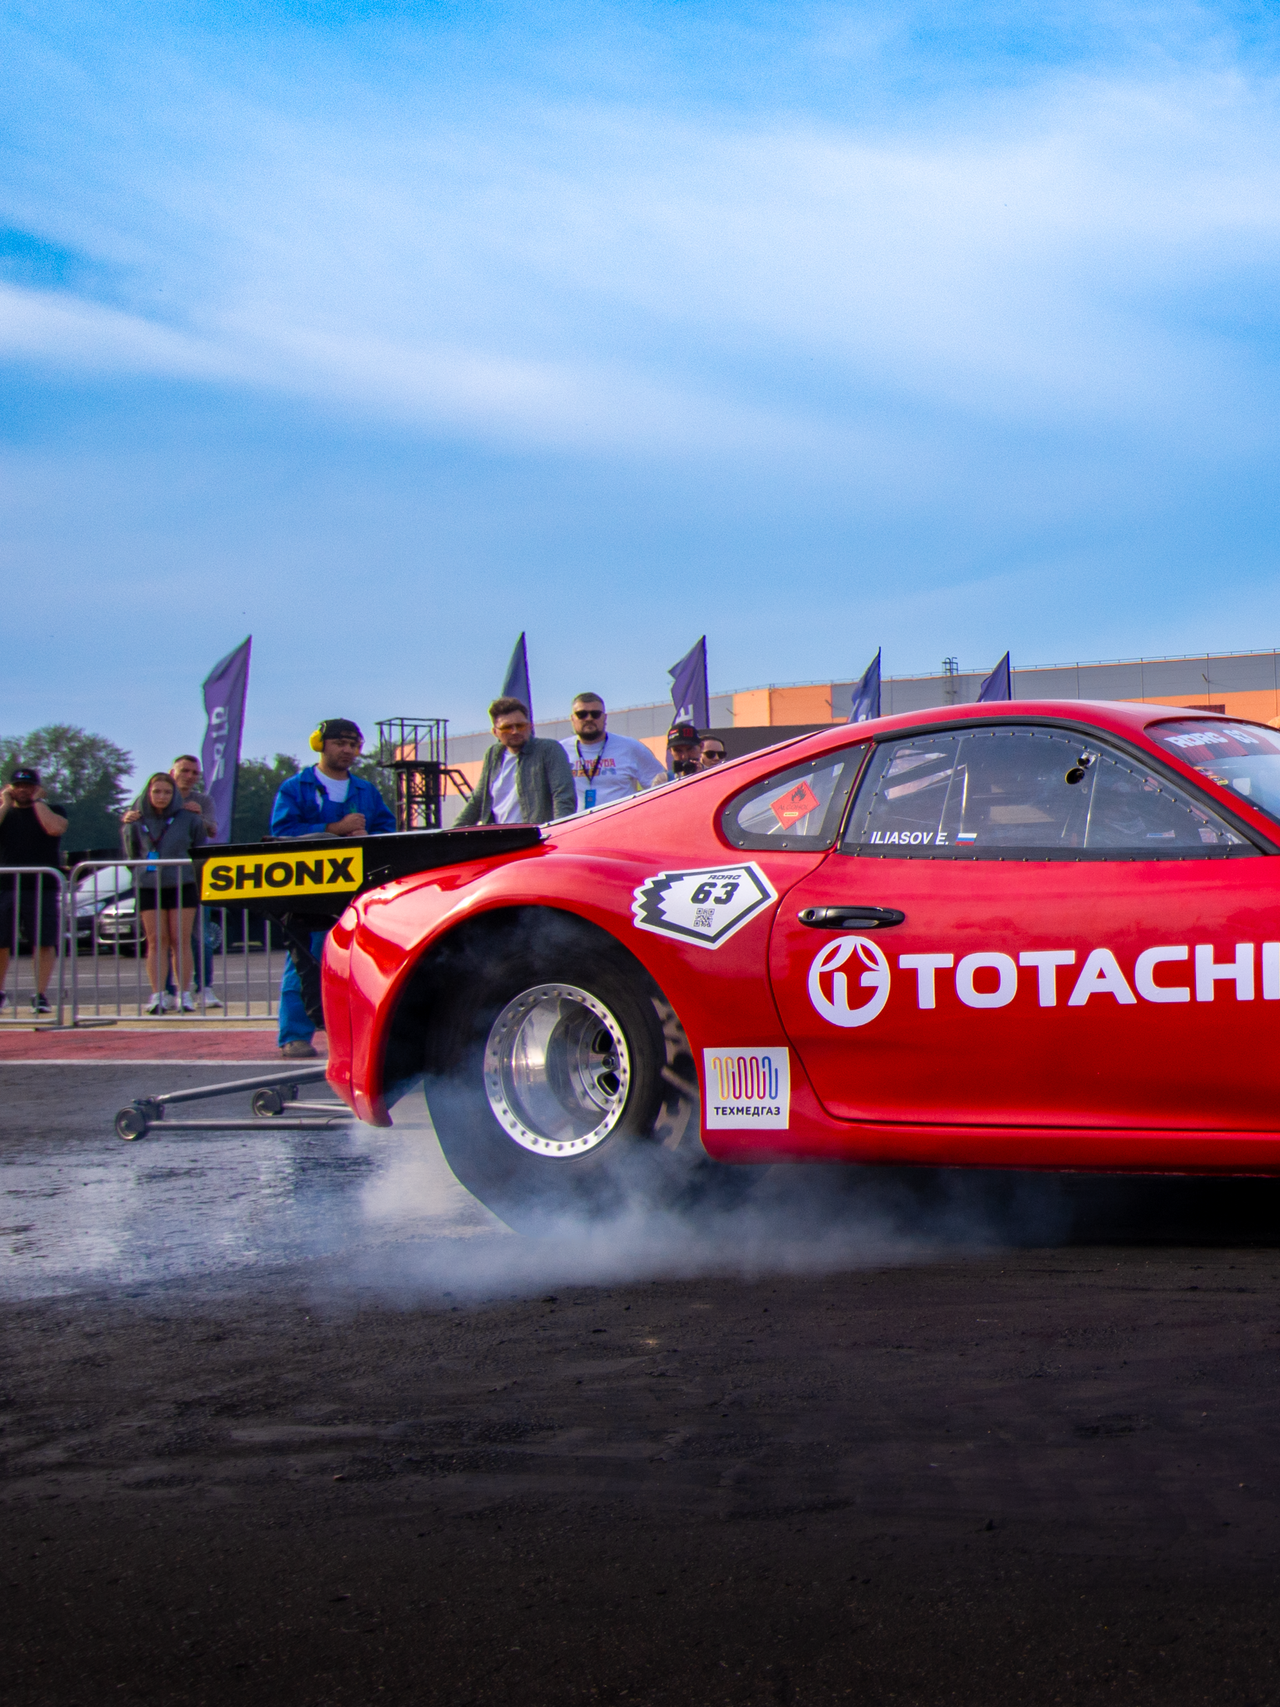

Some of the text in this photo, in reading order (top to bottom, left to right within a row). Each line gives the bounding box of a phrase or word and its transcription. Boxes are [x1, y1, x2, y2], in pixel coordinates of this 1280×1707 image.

[870, 831, 950, 845] ILIASOV E.
[209, 857, 356, 892] SHONX
[690, 882, 740, 905] 63
[714, 1106, 781, 1117] ТЕХМЕДГАЗ
